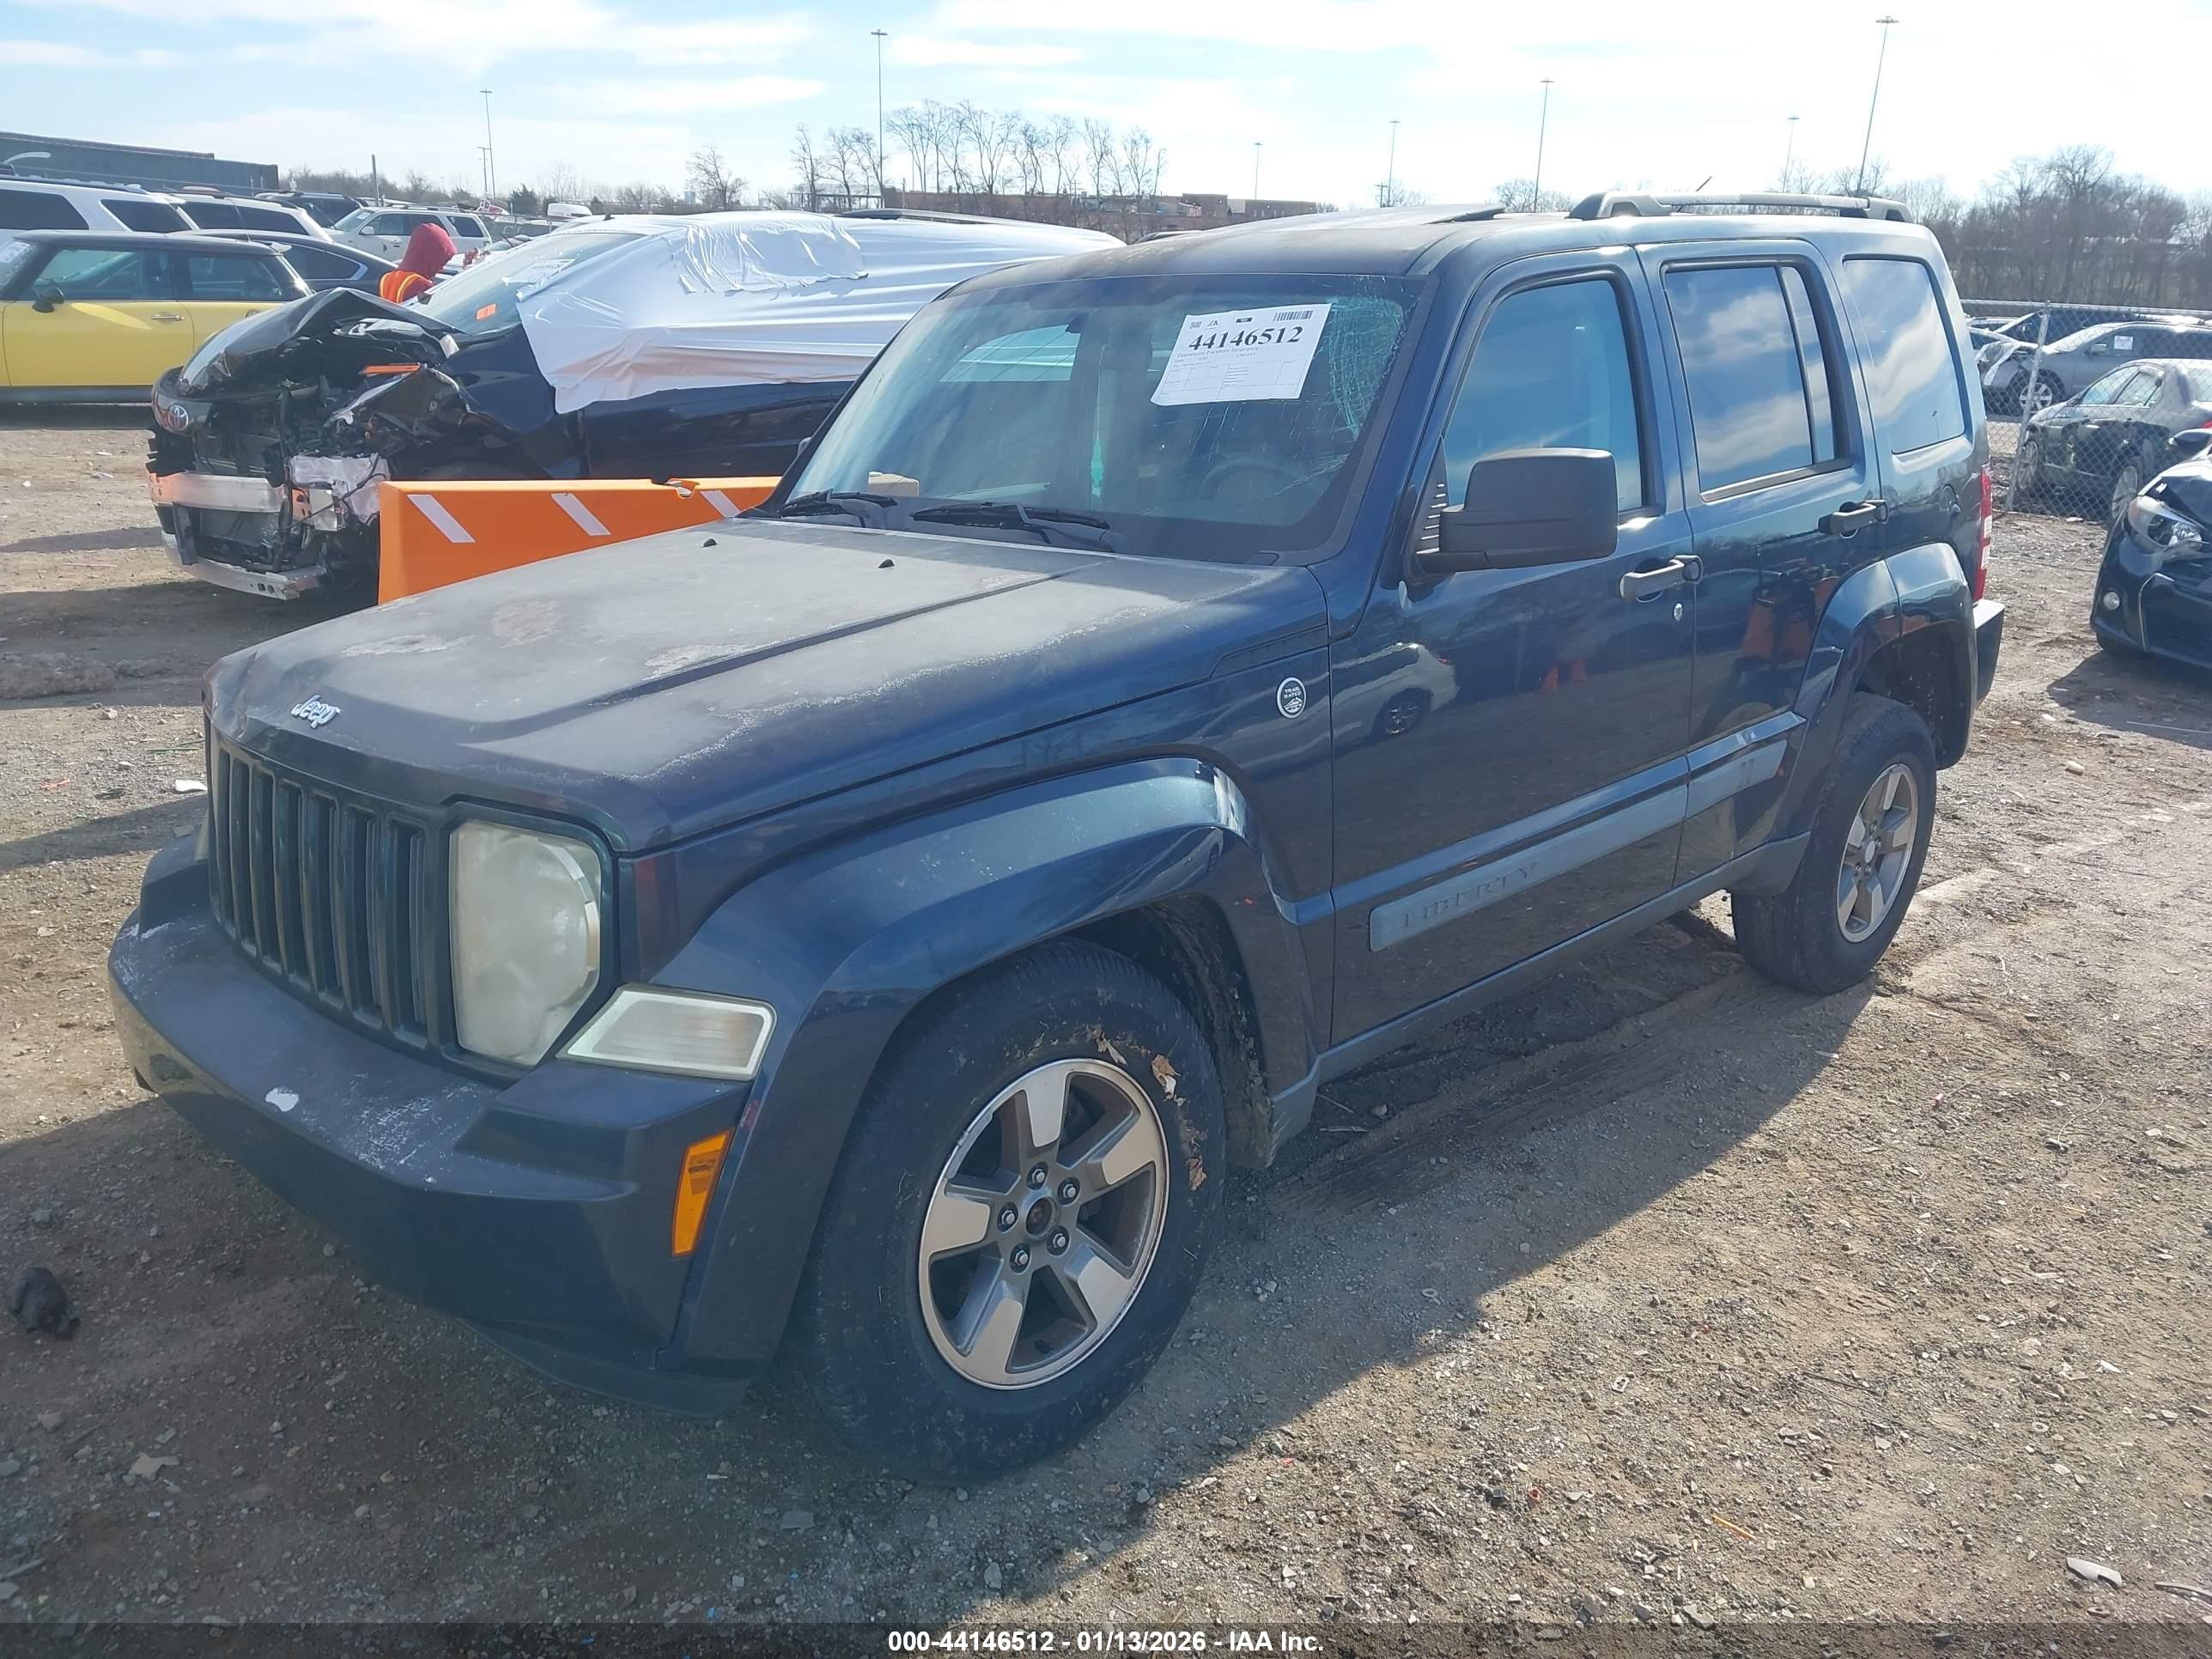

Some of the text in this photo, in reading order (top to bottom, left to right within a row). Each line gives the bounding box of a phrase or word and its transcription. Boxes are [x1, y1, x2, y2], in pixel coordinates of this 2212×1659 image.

[1188, 325, 1304, 350] 44146512
[290, 694, 342, 729] Jeep
[1404, 861, 1538, 928] LIBERTY
